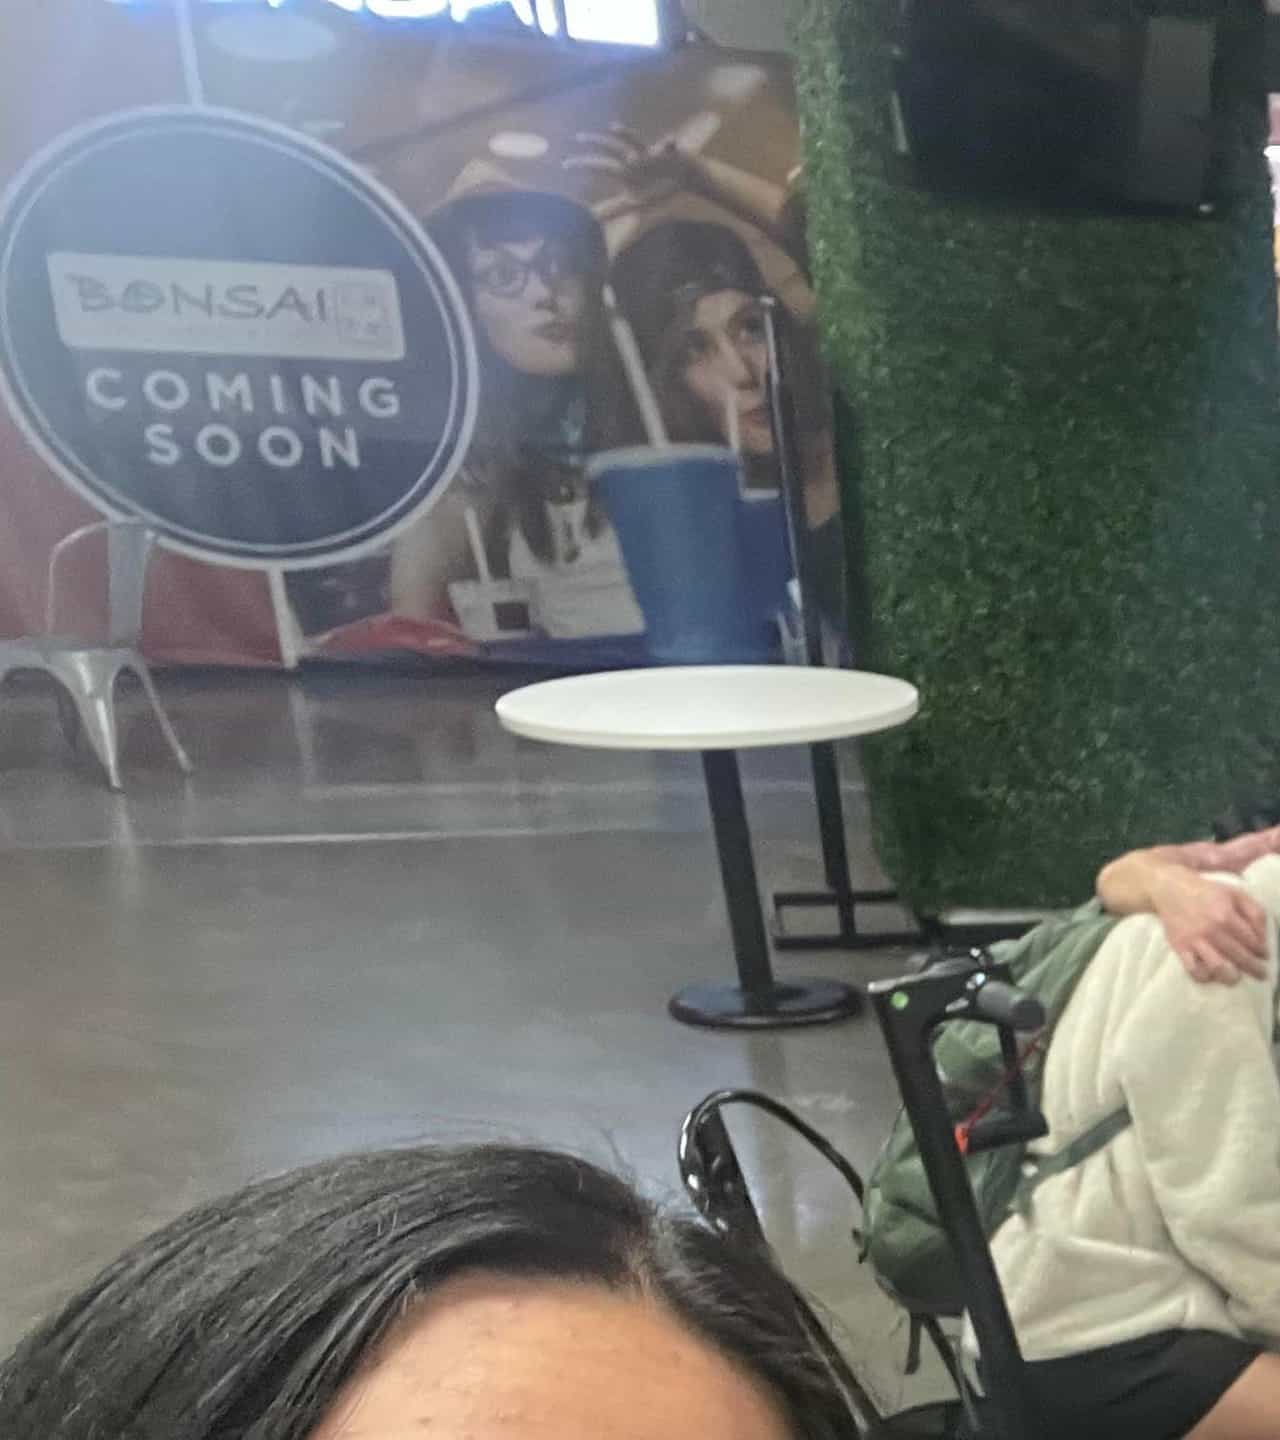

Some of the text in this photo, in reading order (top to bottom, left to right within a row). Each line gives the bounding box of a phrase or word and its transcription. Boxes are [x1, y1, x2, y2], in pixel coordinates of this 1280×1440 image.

[64, 271, 329, 324] BONSAI
[86, 367, 400, 418] COMING
[144, 424, 360, 469] SOON
